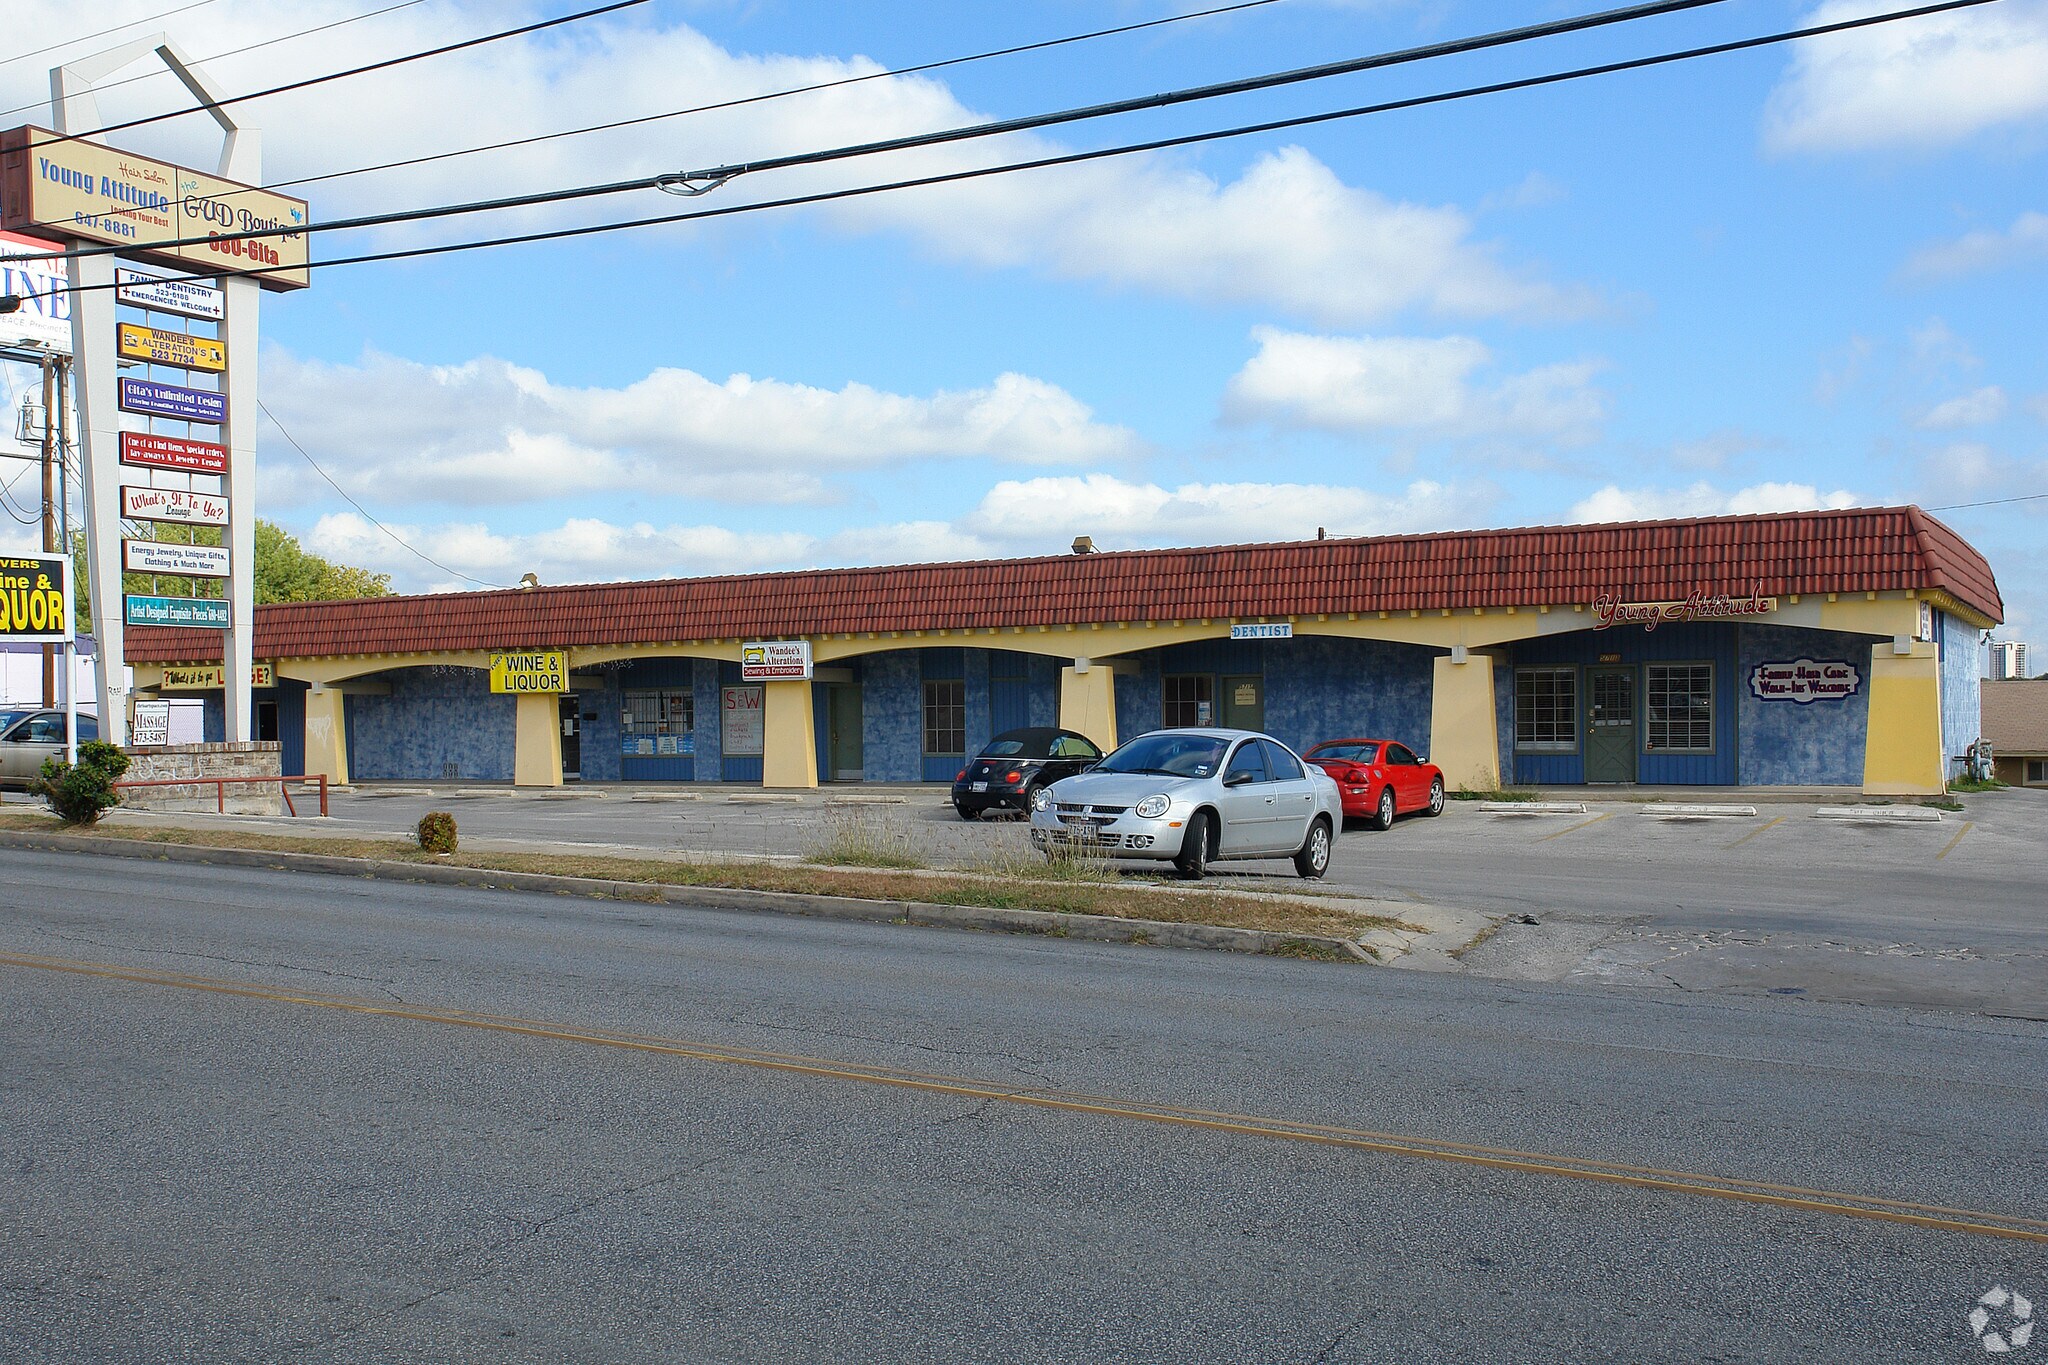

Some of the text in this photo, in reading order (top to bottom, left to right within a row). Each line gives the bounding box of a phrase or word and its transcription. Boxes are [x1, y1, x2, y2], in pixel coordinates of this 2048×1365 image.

[119, 162, 168, 185] Hair Salon
[40, 157, 169, 213] Young Attitude
[181, 180, 199, 194] the
[111, 205, 169, 228] Looking Your Best
[184, 195, 233, 227] GUD
[75, 211, 136, 238] 647-8881
[166, 282, 212, 298] DENTISTRY
[132, 291, 212, 313] EMERGENCIES WELCOME
[151, 330, 194, 346] WANDEE'S
[142, 338, 206, 356] ALTERATION'S
[152, 350, 195, 364] 523 7734
[128, 384, 222, 408] Gita's Unlimited Design
[176, 455, 199, 464] Jewelry
[131, 492, 224, 520] What's It To Ya?
[165, 505, 191, 518] Lounge
[132, 546, 154, 556] Energy
[185, 550, 206, 559] Unique
[145, 558, 171, 568] Clothing
[181, 560, 198, 568] Much
[37, 574, 52, 589] &
[130, 604, 145, 617] Artist
[146, 604, 169, 621] Designed
[170, 605, 192, 622] Exquisite
[192, 606, 207, 620] Pieces
[1592, 581, 1770, 632] Young Attitude
[1233, 625, 1289, 638] DENTIST
[769, 646, 800, 655] Wandee's
[506, 656, 544, 671] WINE
[549, 656, 558, 670] &
[766, 656, 803, 665] Alterations
[745, 667, 764, 675] Sewing
[772, 667, 803, 675] Embroidery
[505, 674, 561, 690] LIQUOR
[135, 714, 166, 728] MASSAGE
[135, 733, 166, 742] 473-5487
